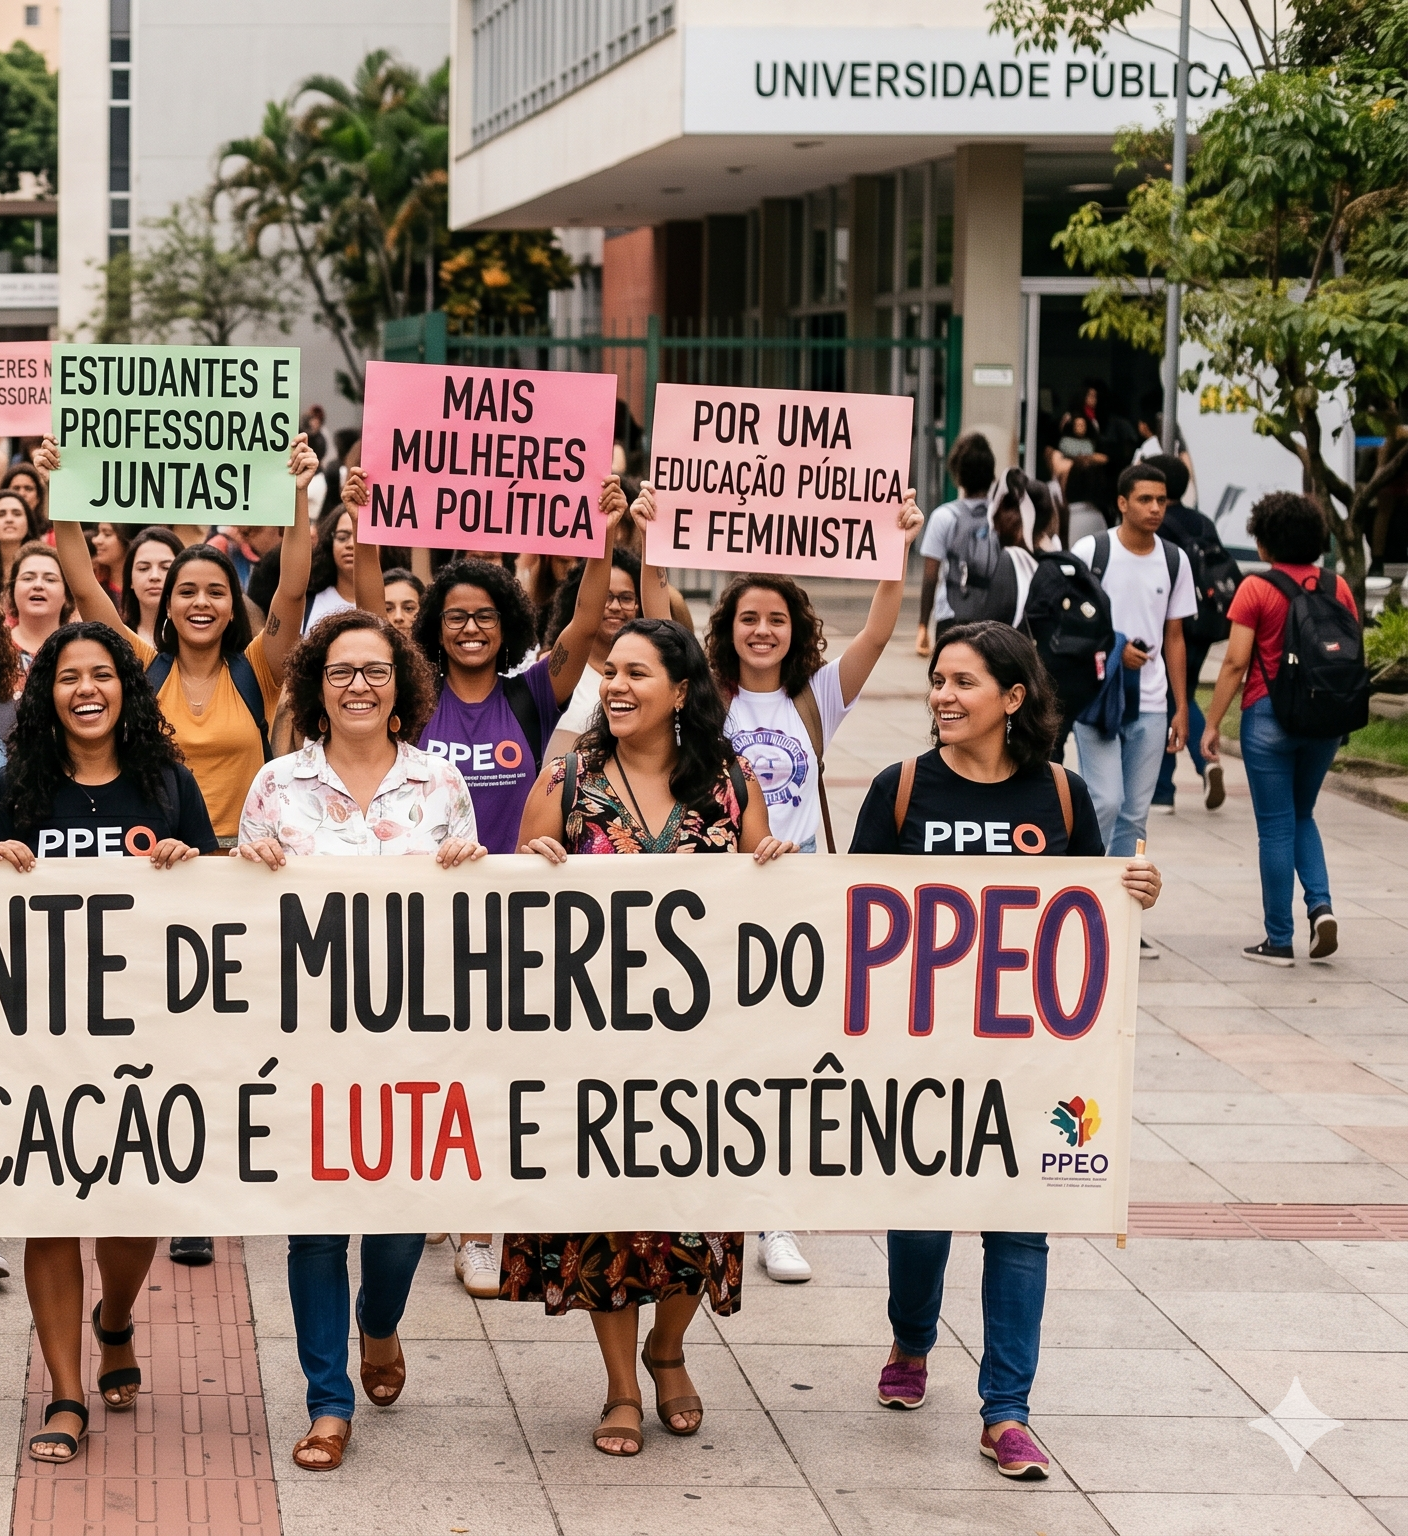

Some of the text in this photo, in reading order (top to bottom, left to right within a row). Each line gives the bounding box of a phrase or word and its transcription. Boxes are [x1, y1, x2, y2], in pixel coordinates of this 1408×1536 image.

[756, 62, 1050, 98] UNIVERSIDADE
[60, 355, 290, 399] ESTUDANTES E
[442, 375, 535, 424] MAIS
[60, 407, 290, 452] PROFESSORAS
[693, 400, 852, 450] POR UMA
[391, 428, 587, 483] MULHERES
[654, 454, 903, 506] EDUCAÇÃO PÚBLICA
[88, 460, 251, 511] JUNTAS!
[370, 480, 594, 540] NA POLÍTICA
[672, 508, 878, 561] E FEMINISTA
[37, 825, 158, 858] PPEO
[924, 821, 1047, 854] PPEO
[166, 922, 250, 1014] DE
[279, 889, 712, 1035] MULHERES
[737, 921, 826, 1008] DO
[843, 882, 1111, 1041] PPEO
[238, 1056, 279, 1183] É
[310, 1081, 483, 1183] LUTA
[509, 1079, 547, 1180] E
[577, 1051, 1019, 1179] RESISTÊNCIA
[1041, 1152, 1109, 1174] PPEO
